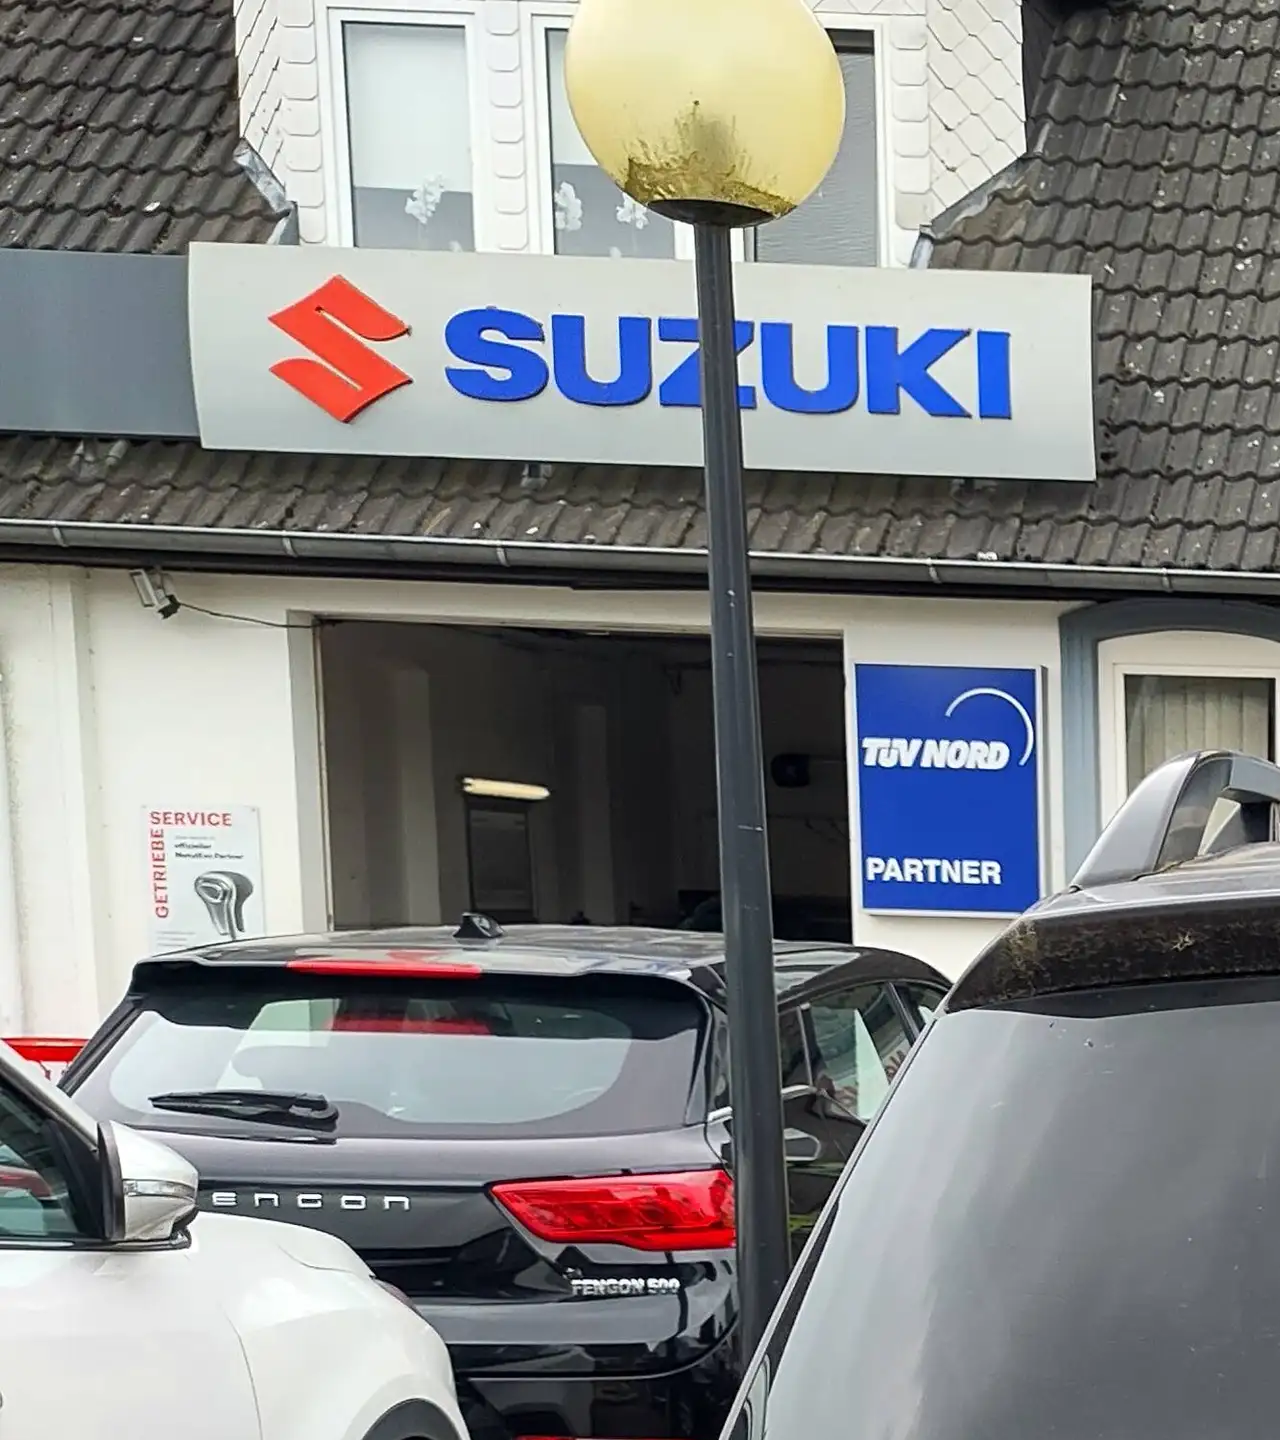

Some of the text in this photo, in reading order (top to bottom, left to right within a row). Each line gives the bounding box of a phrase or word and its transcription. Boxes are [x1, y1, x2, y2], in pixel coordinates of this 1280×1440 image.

[445, 306, 1012, 420] SUZUKI
[862, 737, 1010, 770] TÜV NORD
[150, 811, 232, 827] SERVICE
[150, 828, 169, 919] GETRIEBE
[865, 856, 1001, 884] PARTNER
[212, 1191, 410, 1211] ENGON
